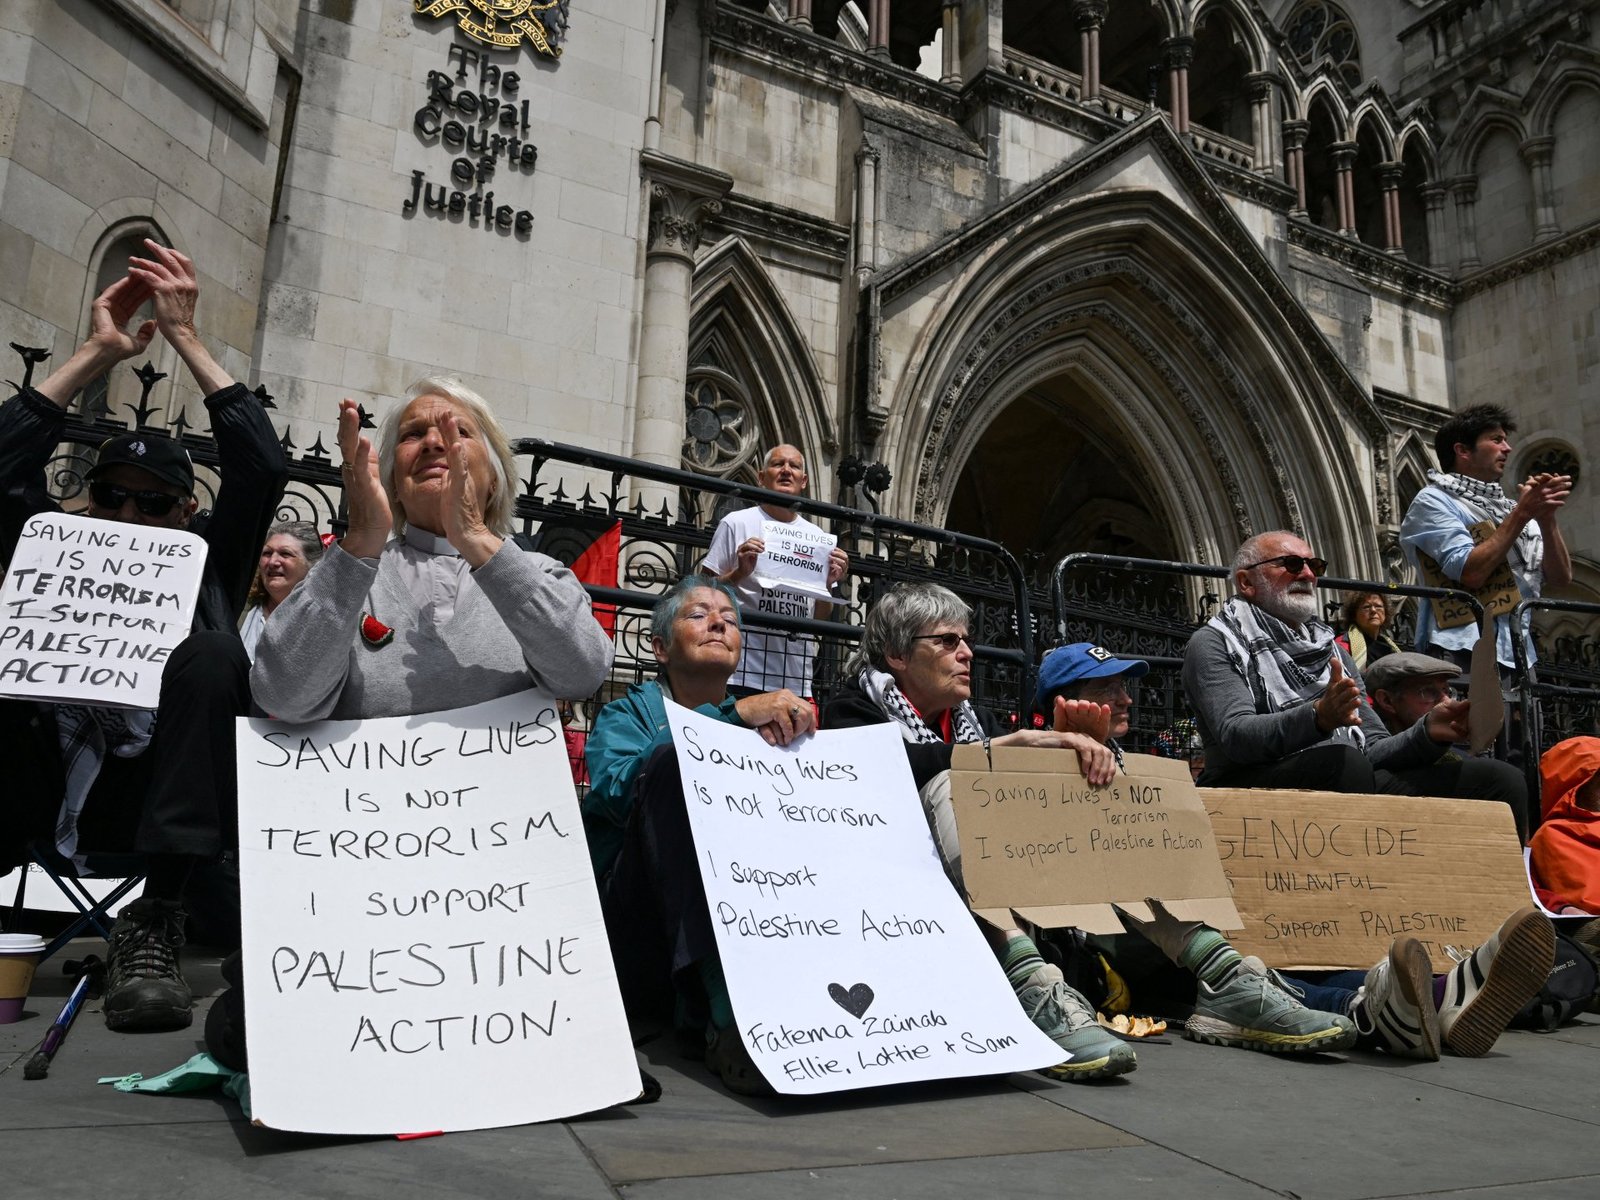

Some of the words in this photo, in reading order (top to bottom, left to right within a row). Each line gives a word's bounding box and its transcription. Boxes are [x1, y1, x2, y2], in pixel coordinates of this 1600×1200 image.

[450, 43, 521, 91] The
[428, 70, 531, 129] Royal
[415, 105, 538, 164] Courts
[452, 156, 497, 184] of
[403, 169, 534, 231] Justice
[22, 520, 120, 548] SAVING
[129, 538, 192, 558] LIVES
[765, 524, 803, 540] SAVING
[805, 533, 834, 546] LIVES
[781, 541, 791, 550] IS
[793, 543, 815, 556] NOT
[56, 550, 85, 570] IS
[102, 558, 174, 578] NOT
[768, 551, 824, 573] TERRORISM
[13, 568, 180, 610] TERRORISM
[7, 599, 47, 620] I
[758, 600, 809, 618] PALESTINE
[0, 626, 173, 663] PALESTINE
[0, 658, 139, 689] ACTION
[257, 732, 445, 773] SAVING
[458, 708, 557, 757] LIVES
[682, 726, 794, 795] Saving
[796, 758, 858, 782] lives
[345, 788, 380, 812] IS
[406, 786, 479, 809] NOT
[693, 780, 713, 804] is
[725, 793, 764, 819] not
[779, 798, 887, 827] terrorism
[972, 778, 1048, 808] Saving
[1061, 783, 1100, 805] Lives
[1108, 787, 1120, 801] is
[1130, 785, 1162, 804] NOT
[1102, 808, 1168, 825] Terrorism
[261, 811, 569, 860] TERRORISM
[975, 836, 991, 859] I
[1004, 833, 1077, 868] support
[1090, 828, 1155, 852] Palestine
[1162, 829, 1203, 850] Action
[707, 850, 717, 878] I
[730, 862, 817, 899] support
[1265, 871, 1387, 892] UNLAWFUL
[366, 882, 530, 916] SUPPORT
[717, 901, 841, 939] Palestine
[861, 909, 945, 941] Action
[1264, 914, 1340, 940] SUPPORT
[1359, 910, 1469, 937] PALESTINE
[271, 936, 582, 993] PALESTINE
[748, 1022, 854, 1055] Fatema
[861, 1009, 948, 1037] Zainab
[858, 1044, 931, 1069] Lottie
[961, 1032, 1018, 1055] Sam
